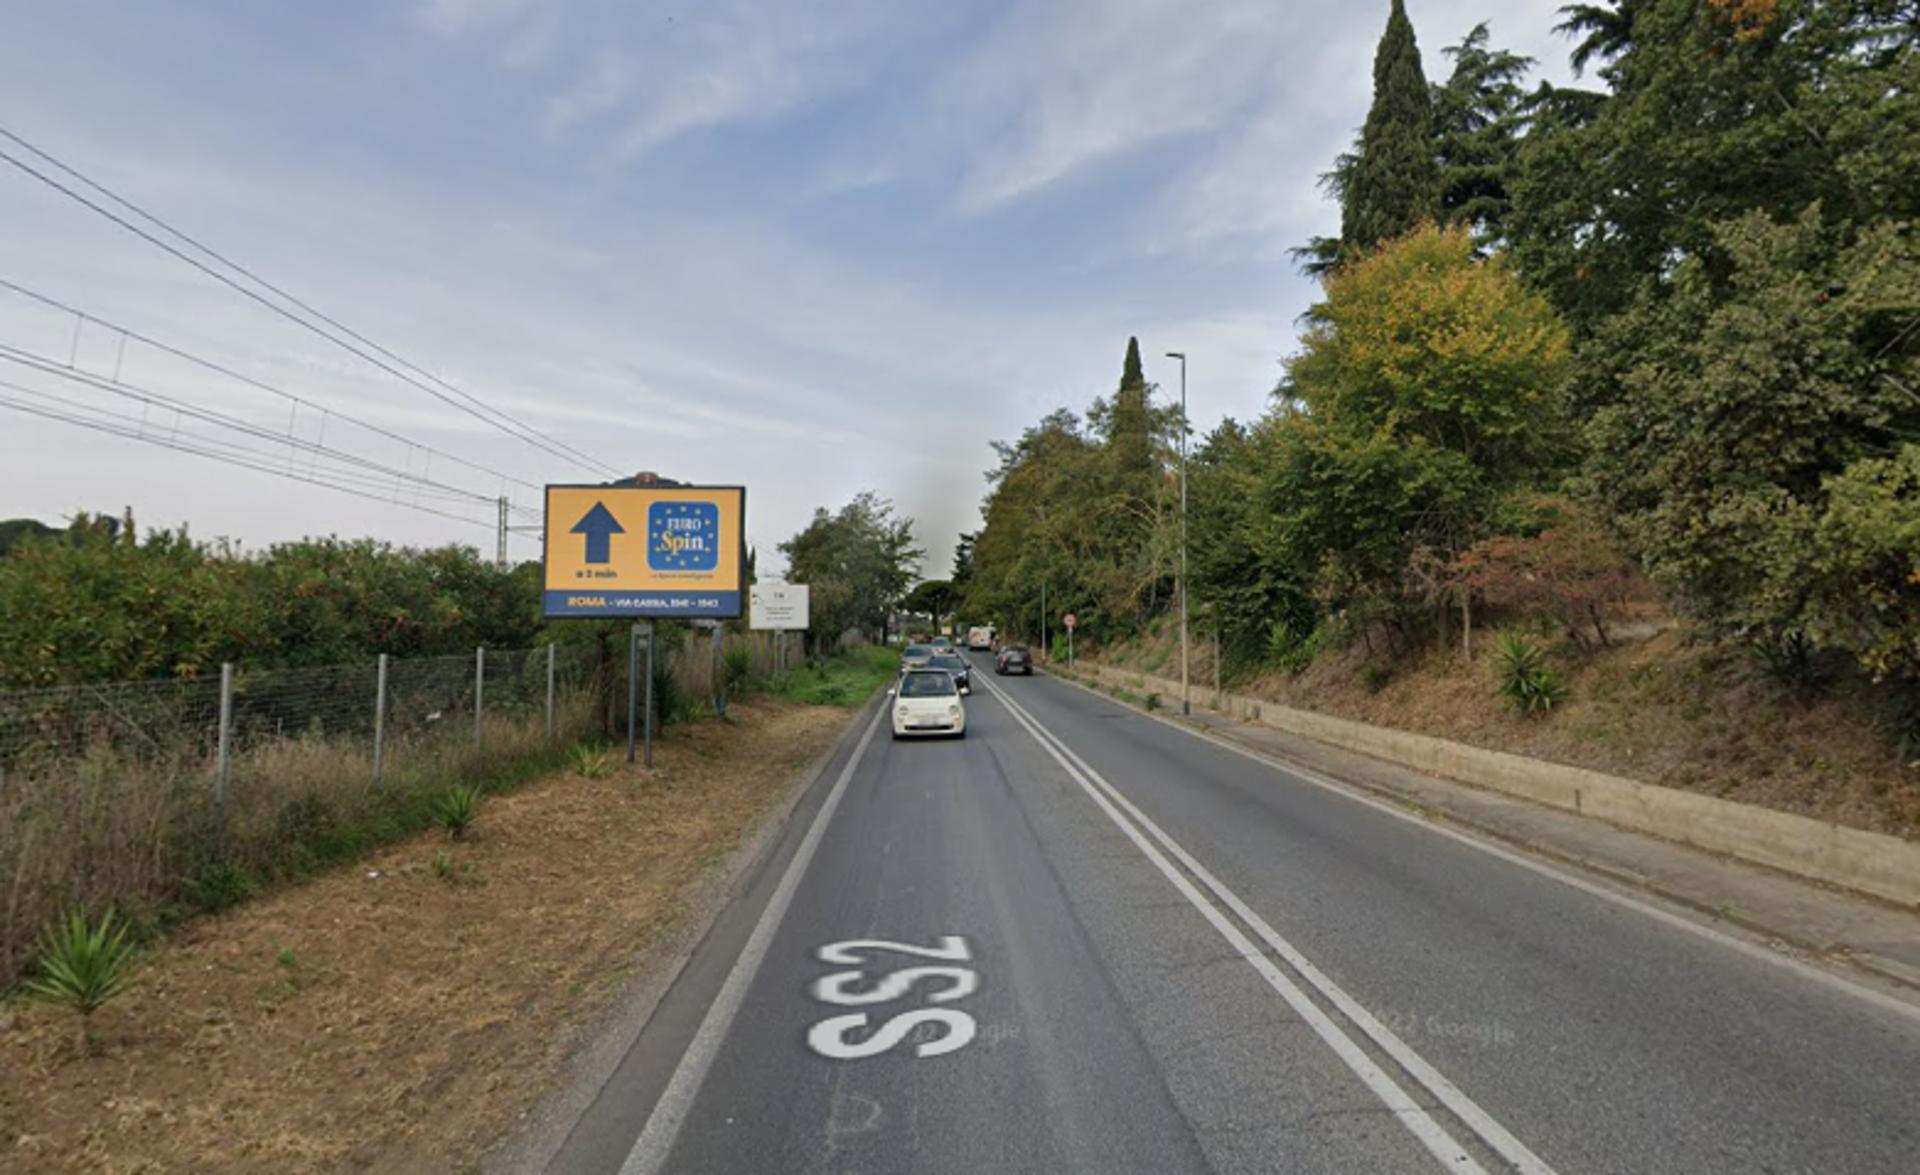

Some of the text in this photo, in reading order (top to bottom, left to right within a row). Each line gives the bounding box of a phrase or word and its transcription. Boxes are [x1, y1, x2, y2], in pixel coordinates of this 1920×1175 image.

[667, 517, 703, 530] EURO
[660, 530, 704, 556] Spin
[567, 596, 607, 608] ROMA
[615, 598, 632, 608] VIA
[808, 936, 978, 1058] SS2
